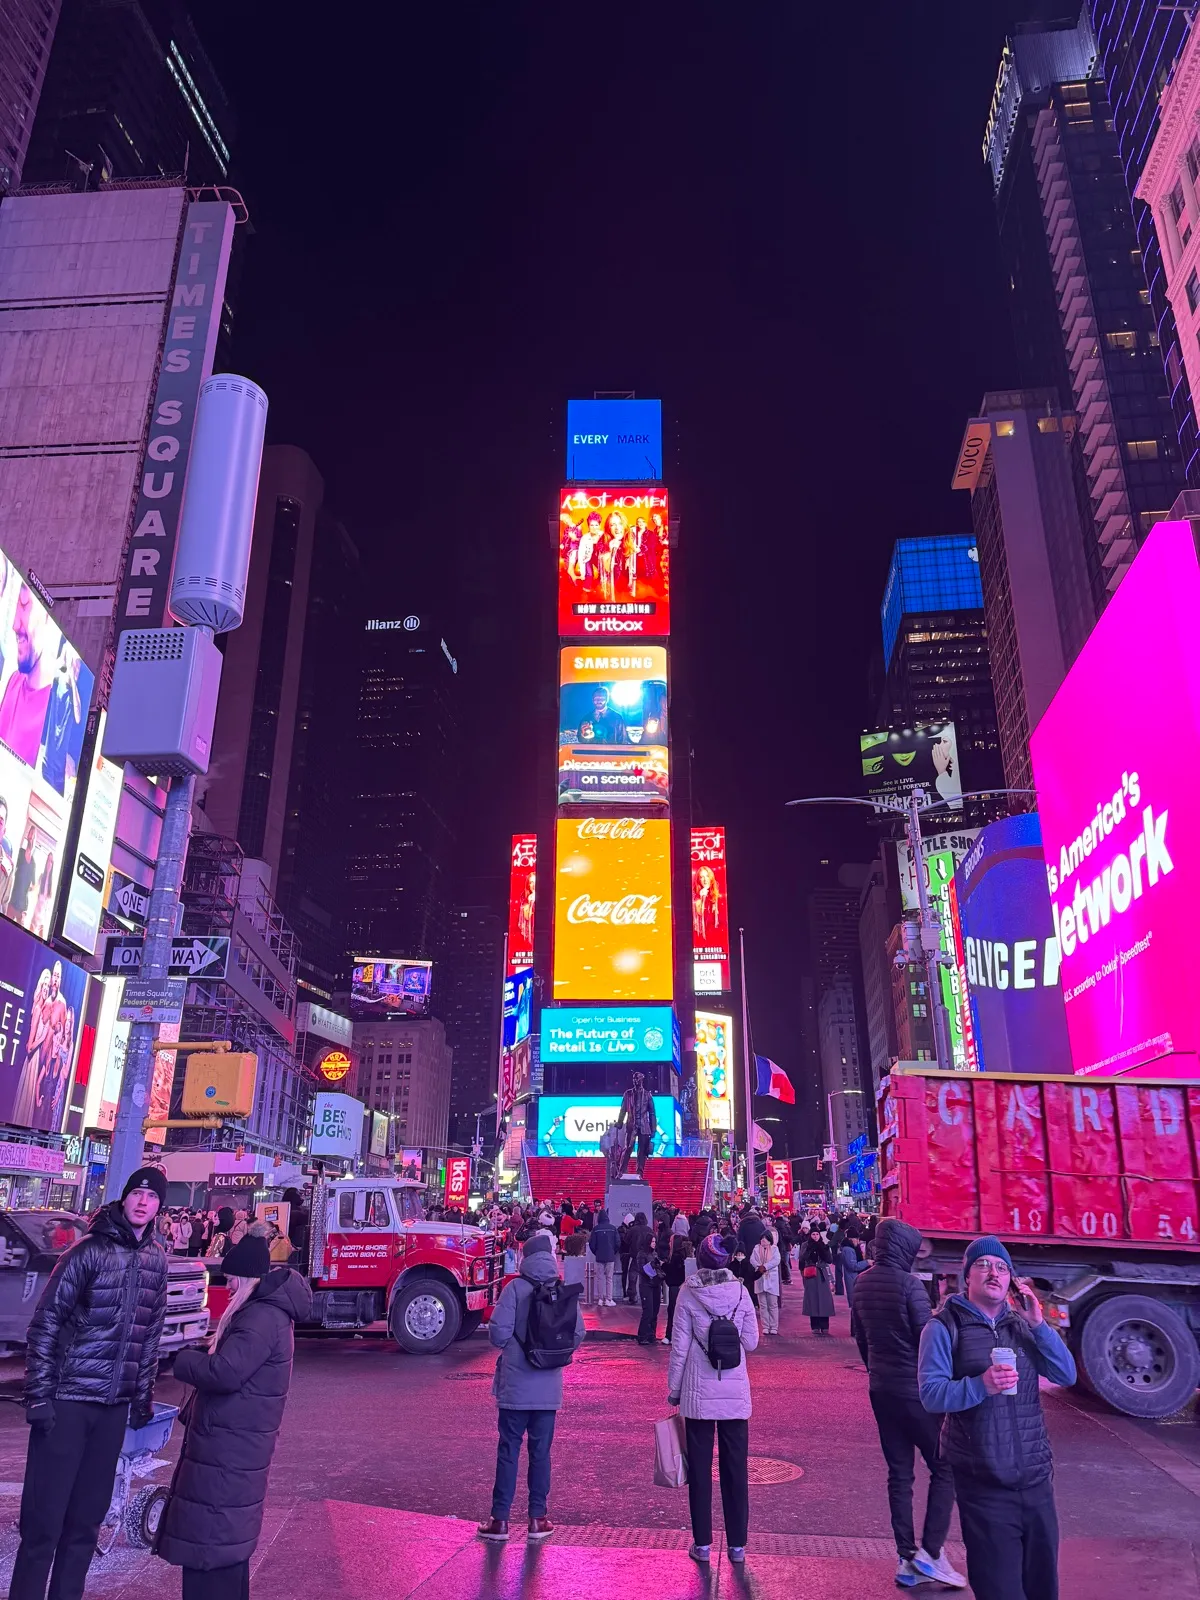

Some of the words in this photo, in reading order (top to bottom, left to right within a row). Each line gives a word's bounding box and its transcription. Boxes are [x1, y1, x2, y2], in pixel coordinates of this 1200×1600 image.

[164, 222, 213, 373] TIMES
[573, 435, 609, 444] EVERY
[617, 435, 650, 443] MARK
[126, 400, 183, 616] SQUARE
[578, 604, 597, 614] NOW
[365, 619, 401, 631] llianz
[584, 617, 643, 632] britbox
[574, 657, 653, 670] SAMSUNG
[563, 759, 614, 771] Discover
[619, 759, 663, 771] what's
[581, 775, 599, 785] on
[600, 773, 645, 785] screen
[576, 817, 648, 839] Coca-Cola
[1059, 771, 1141, 885] America's
[690, 849, 724, 861] OMEN
[122, 890, 144, 912] ONE
[567, 894, 663, 924] Coca-Cola
[121, 949, 142, 964] ON
[172, 949, 208, 964] WAY
[940, 883, 964, 1035] CANNABIS
[1073, 974, 1097, 998] according
[125, 989, 146, 997] Times
[146, 989, 173, 998] Square
[1, 1001, 25, 1036] EE
[572, 1016, 591, 1025] Open
[607, 1016, 641, 1024] Business
[550, 1028, 573, 1039] The
[576, 1028, 618, 1039] Future
[621, 1027, 634, 1039] of
[549, 1041, 587, 1053] Retail
[589, 1042, 602, 1053] Is
[608, 1041, 635, 1053] Live
[323, 1101, 333, 1109] the
[214, 1176, 257, 1186] KLIKTIX
[451, 1160, 467, 1192] tkts
[772, 1164, 789, 1196] tkts
